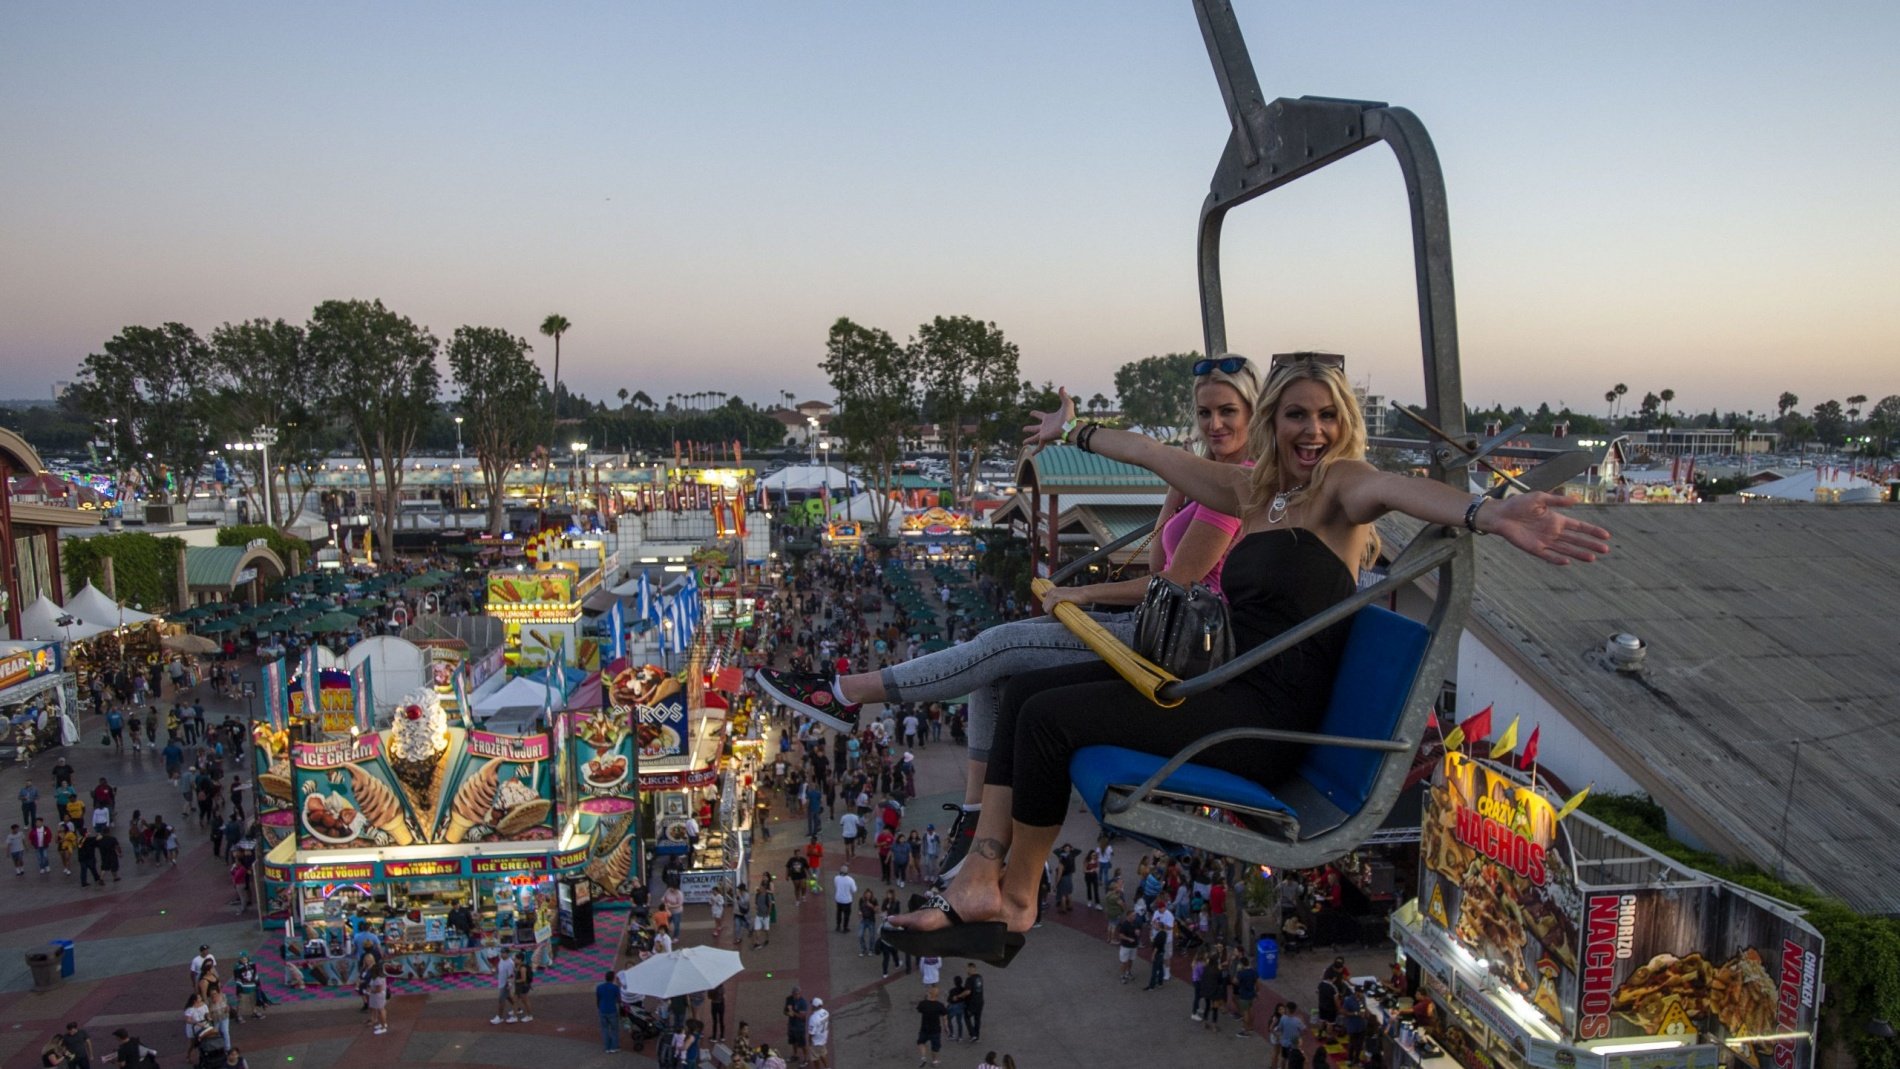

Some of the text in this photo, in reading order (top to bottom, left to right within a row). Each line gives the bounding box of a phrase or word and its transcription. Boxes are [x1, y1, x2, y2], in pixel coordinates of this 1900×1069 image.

[303, 743, 373, 766] ICE CREAM
[473, 740, 508, 757] FROZEN
[1478, 795, 1516, 828] CRAZY
[560, 851, 586, 866] CONES
[1456, 803, 1546, 887] NACHOS
[299, 867, 371, 881] FROZEN YOGURT
[393, 864, 453, 877] BANANAS
[477, 860, 542, 872] ICE CREAM
[1616, 894, 1637, 960] CHORIZO
[1580, 895, 1620, 1040] NACHOS
[1801, 950, 1817, 1008] CHICKEN
[1774, 938, 1804, 1069] NACHOS
